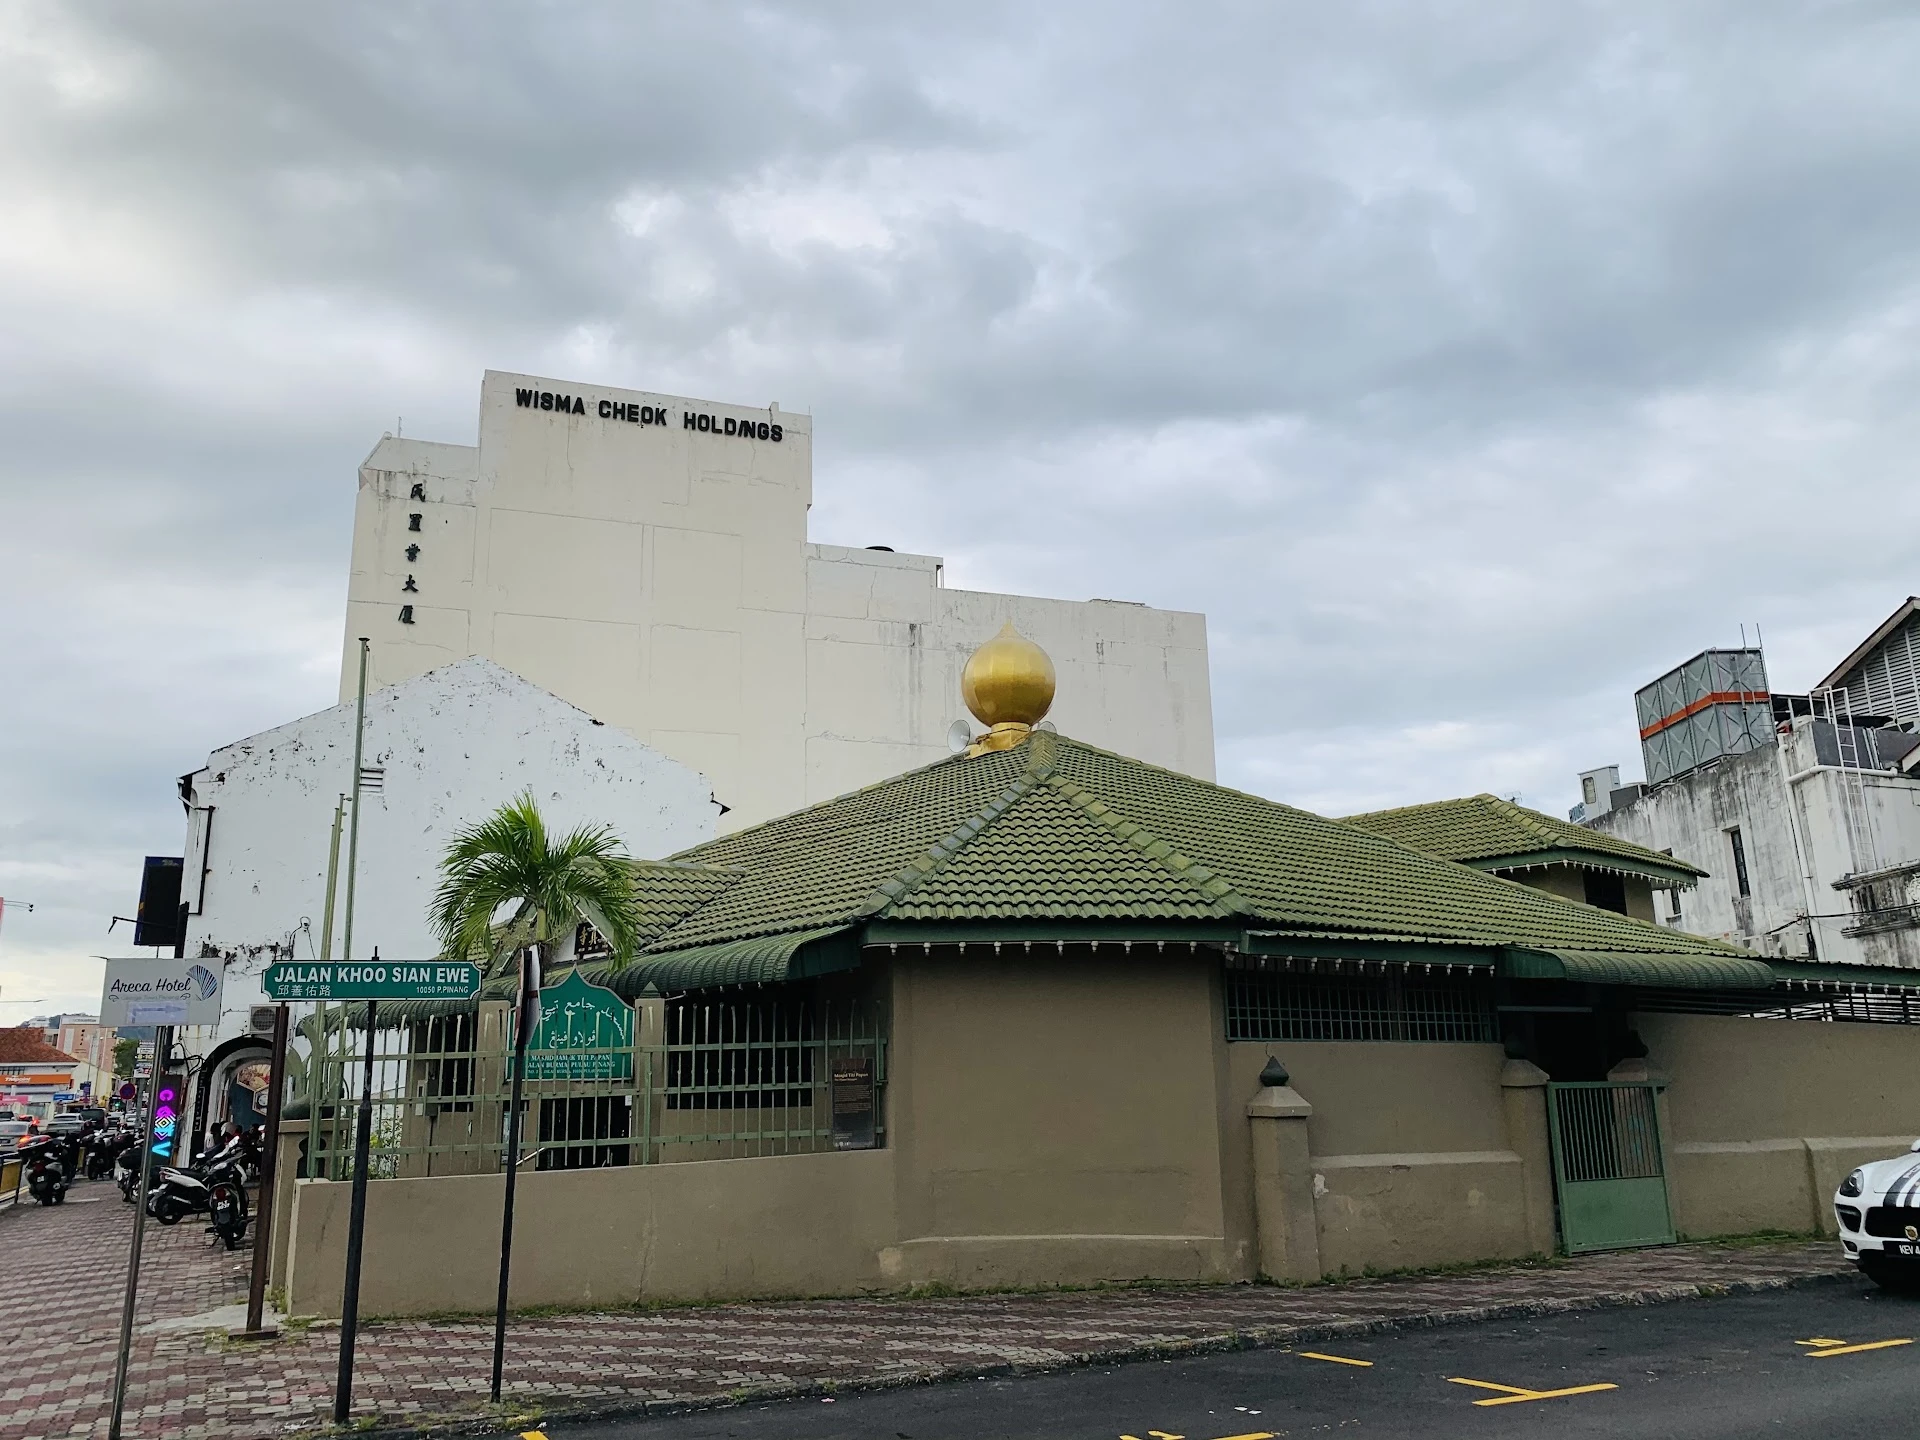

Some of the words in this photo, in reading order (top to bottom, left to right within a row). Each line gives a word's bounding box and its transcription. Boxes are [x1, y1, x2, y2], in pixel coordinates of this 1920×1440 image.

[515, 387, 585, 415] WISMA
[597, 400, 668, 427] CHEOK
[683, 411, 783, 442] HOLDINGS
[274, 967, 331, 983] JALAN
[337, 967, 386, 983] KHOO
[391, 967, 430, 983] SIAN
[436, 967, 469, 983] EWE
[111, 978, 152, 993] Areca
[155, 977, 191, 992] Hotel
[276, 984, 331, 997] 邱善佑路
[416, 986, 435, 994] 10050
[437, 986, 468, 994] P.PINANG
